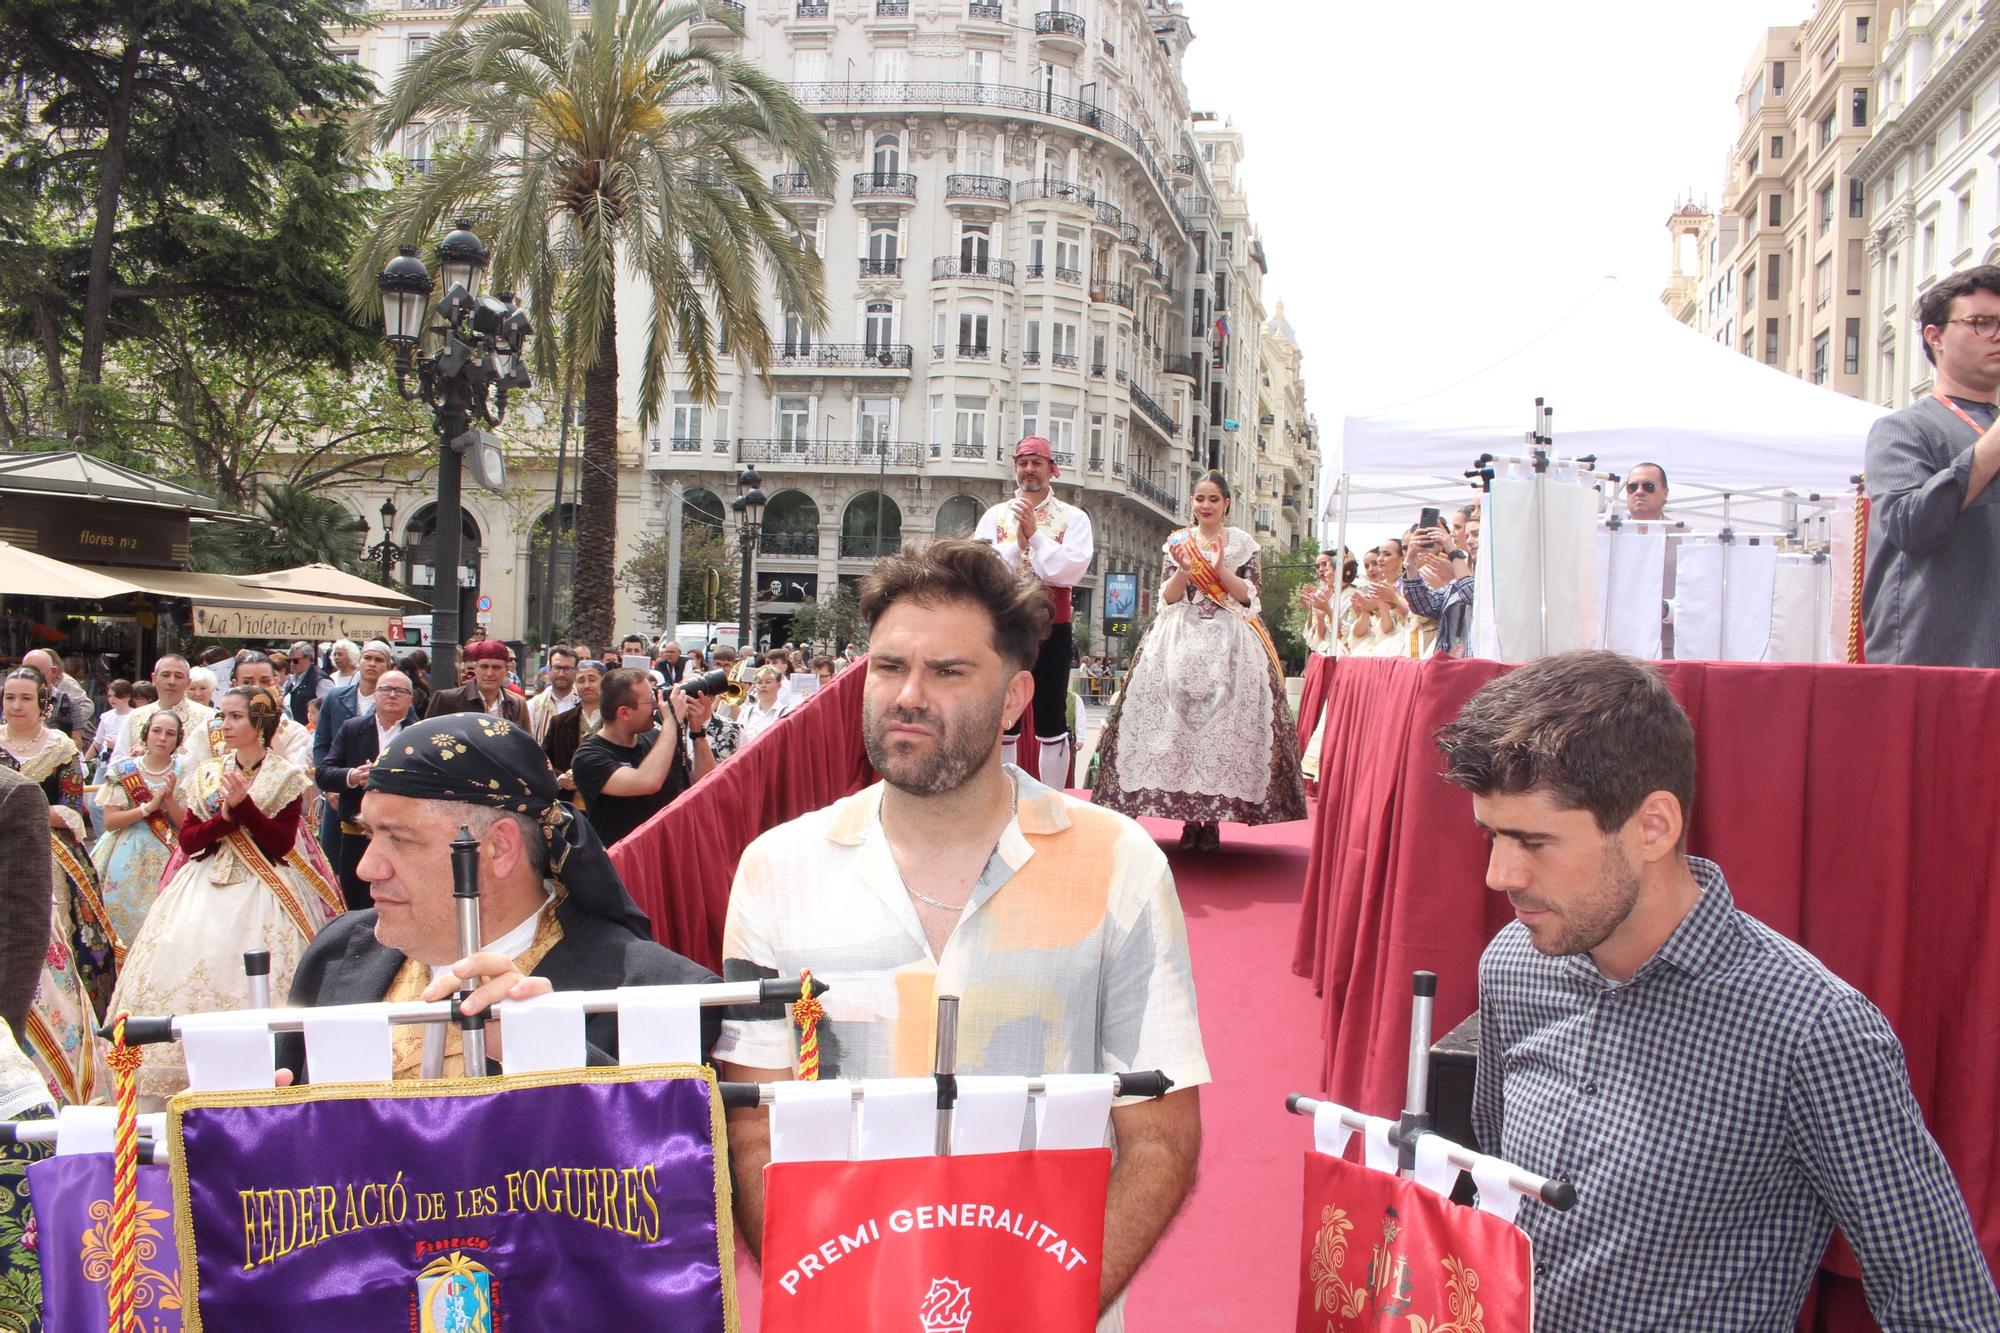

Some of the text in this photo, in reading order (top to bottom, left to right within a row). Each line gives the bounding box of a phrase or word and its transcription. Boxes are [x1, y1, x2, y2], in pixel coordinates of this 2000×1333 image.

[80, 530, 114, 546] flores
[208, 614, 227, 634] La
[392, 626, 399, 639] 2
[238, 1162, 661, 1271] FEDERACIÓ DE LES FOGUERES
[778, 1203, 1088, 1296] PREMI GENERALITAT
